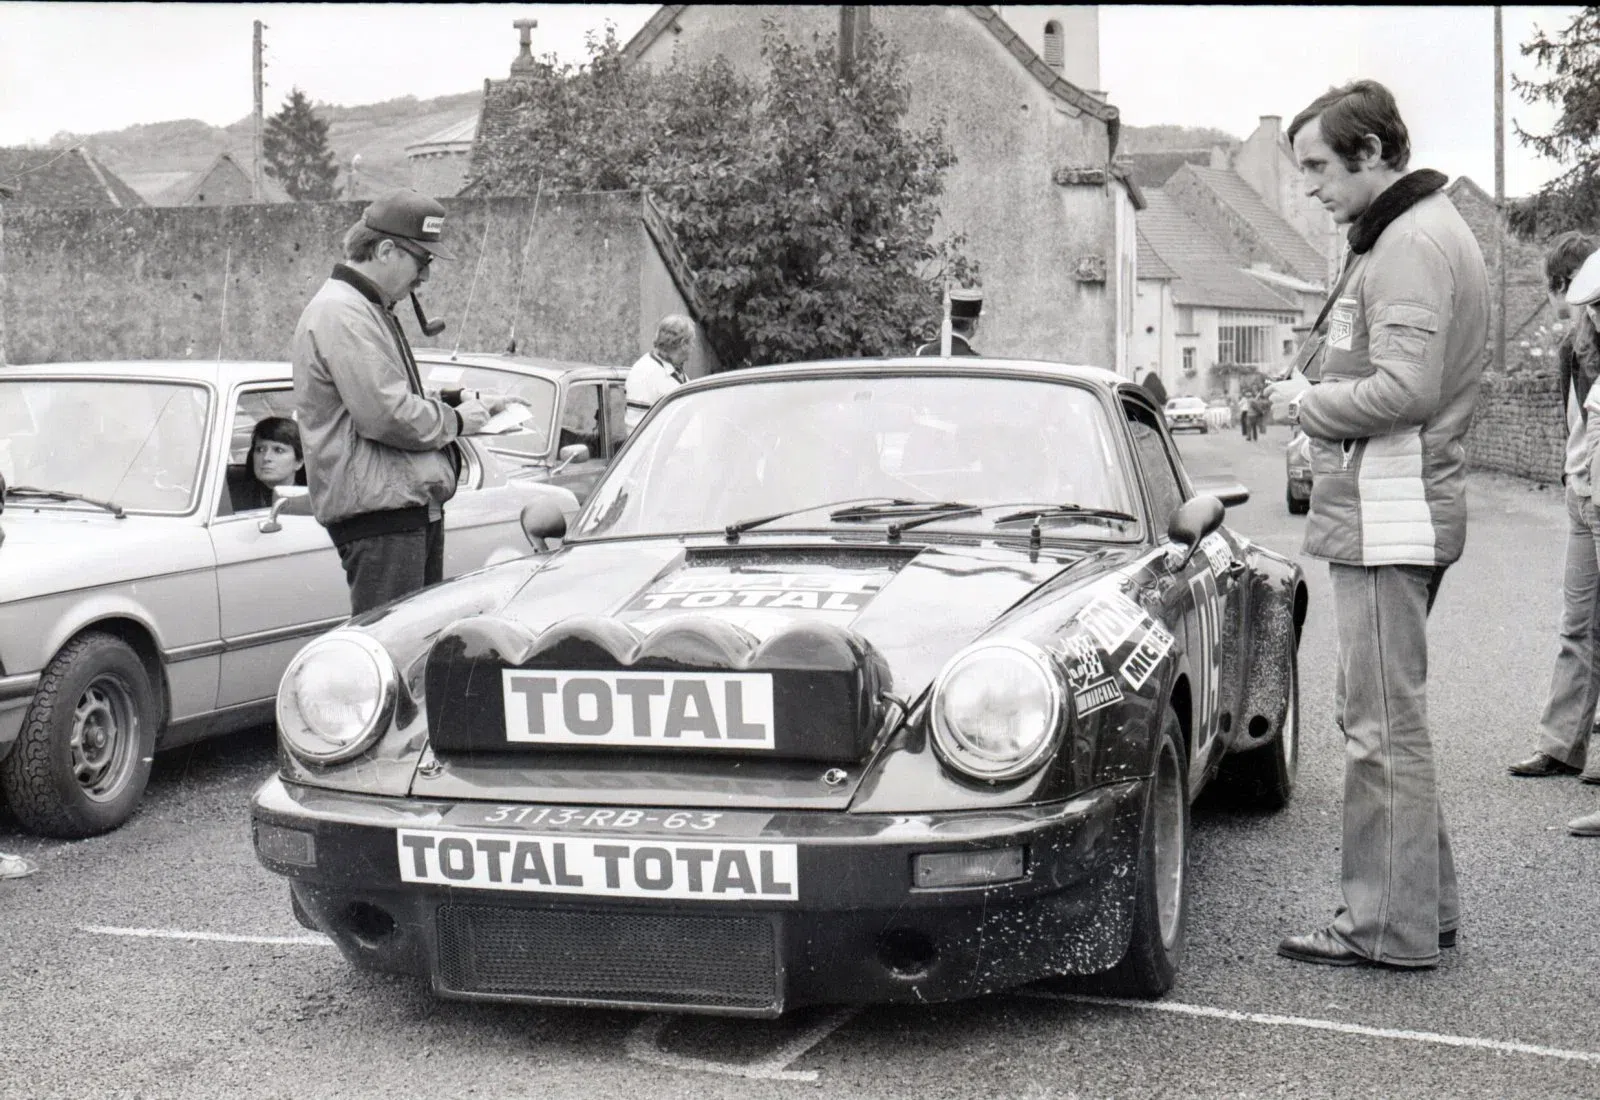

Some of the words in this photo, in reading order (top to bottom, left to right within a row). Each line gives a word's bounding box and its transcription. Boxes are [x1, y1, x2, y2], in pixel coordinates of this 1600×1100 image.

[644, 591, 860, 610] TOTAL
[510, 676, 766, 740] TOTAL
[484, 806, 724, 831] 3113-RB-63
[402, 834, 584, 887] TOTAL
[594, 844, 792, 895] TOTAL
